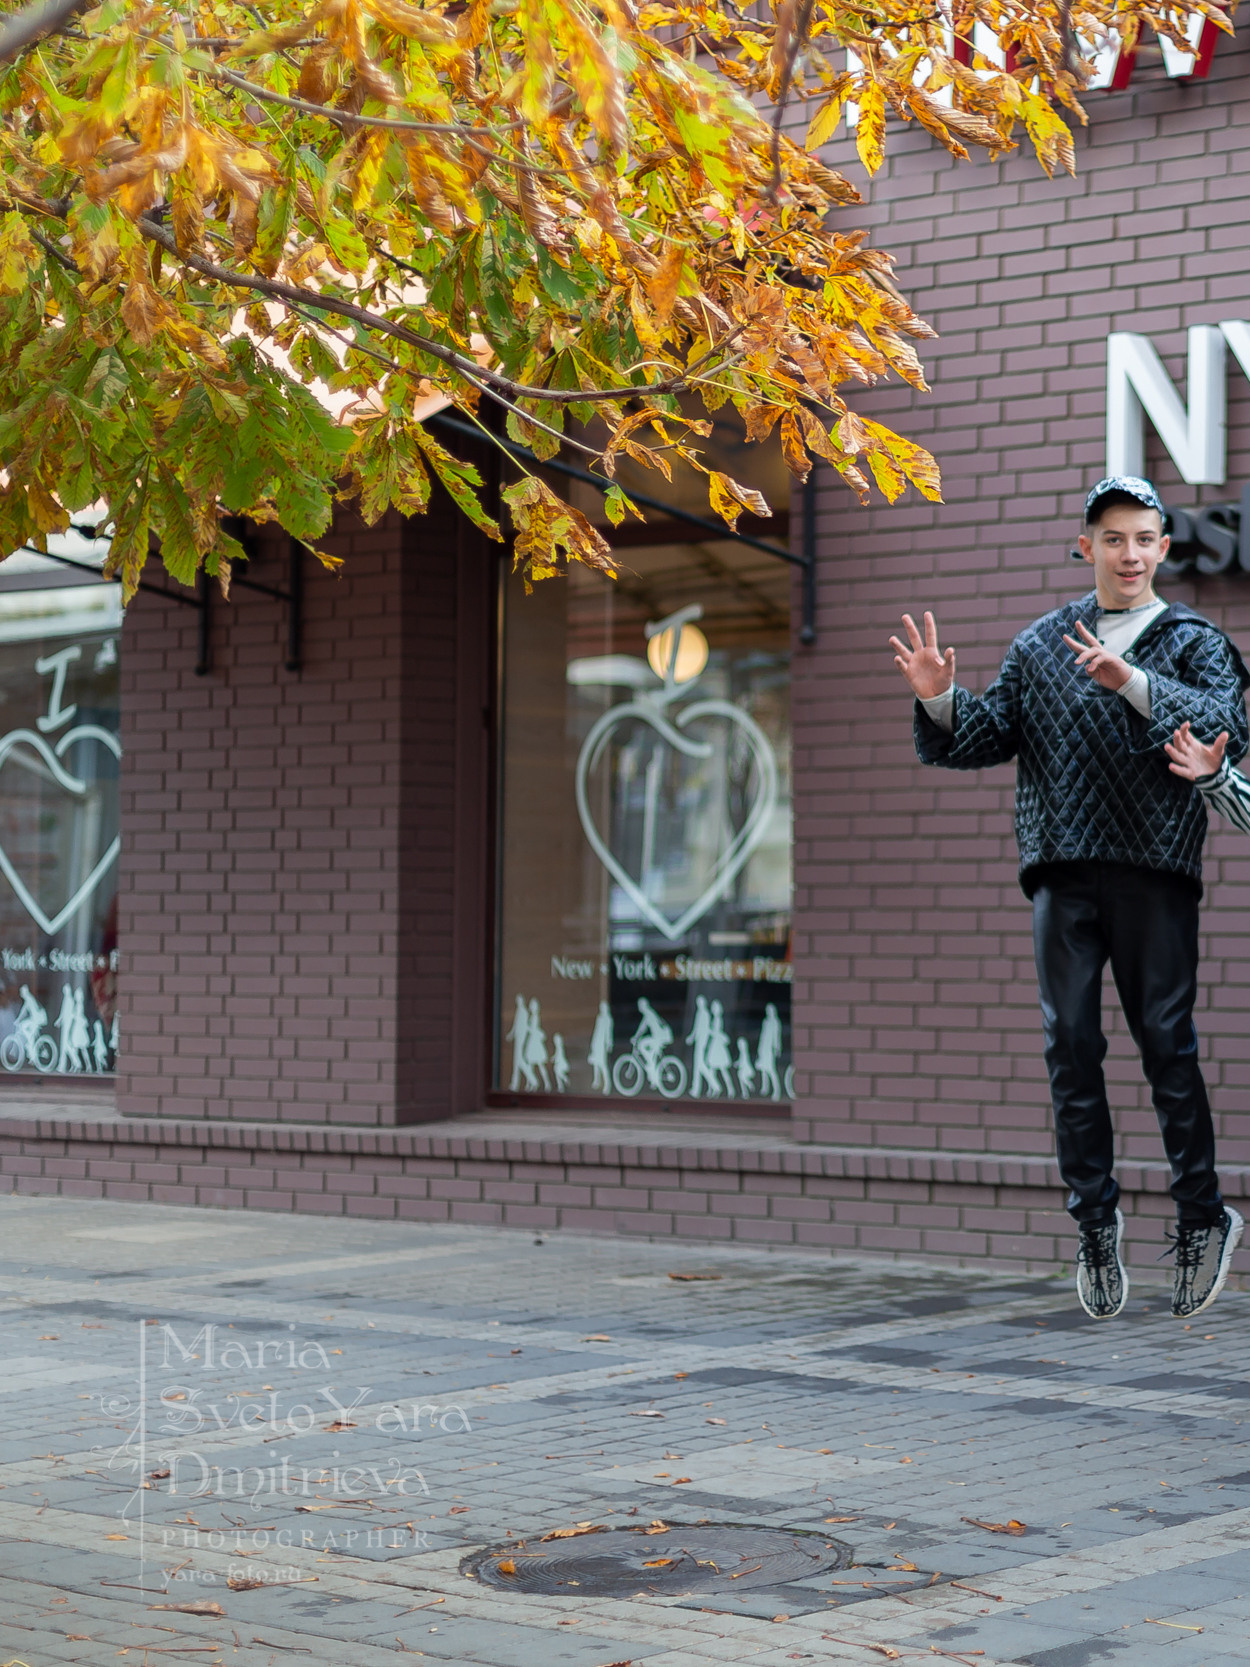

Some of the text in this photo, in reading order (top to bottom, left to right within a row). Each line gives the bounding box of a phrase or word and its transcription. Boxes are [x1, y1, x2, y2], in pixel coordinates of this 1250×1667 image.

[1, 946, 36, 971] York
[49, 947, 94, 972] Street
[550, 953, 595, 980] New
[612, 952, 659, 981] York
[674, 953, 733, 982] Street
